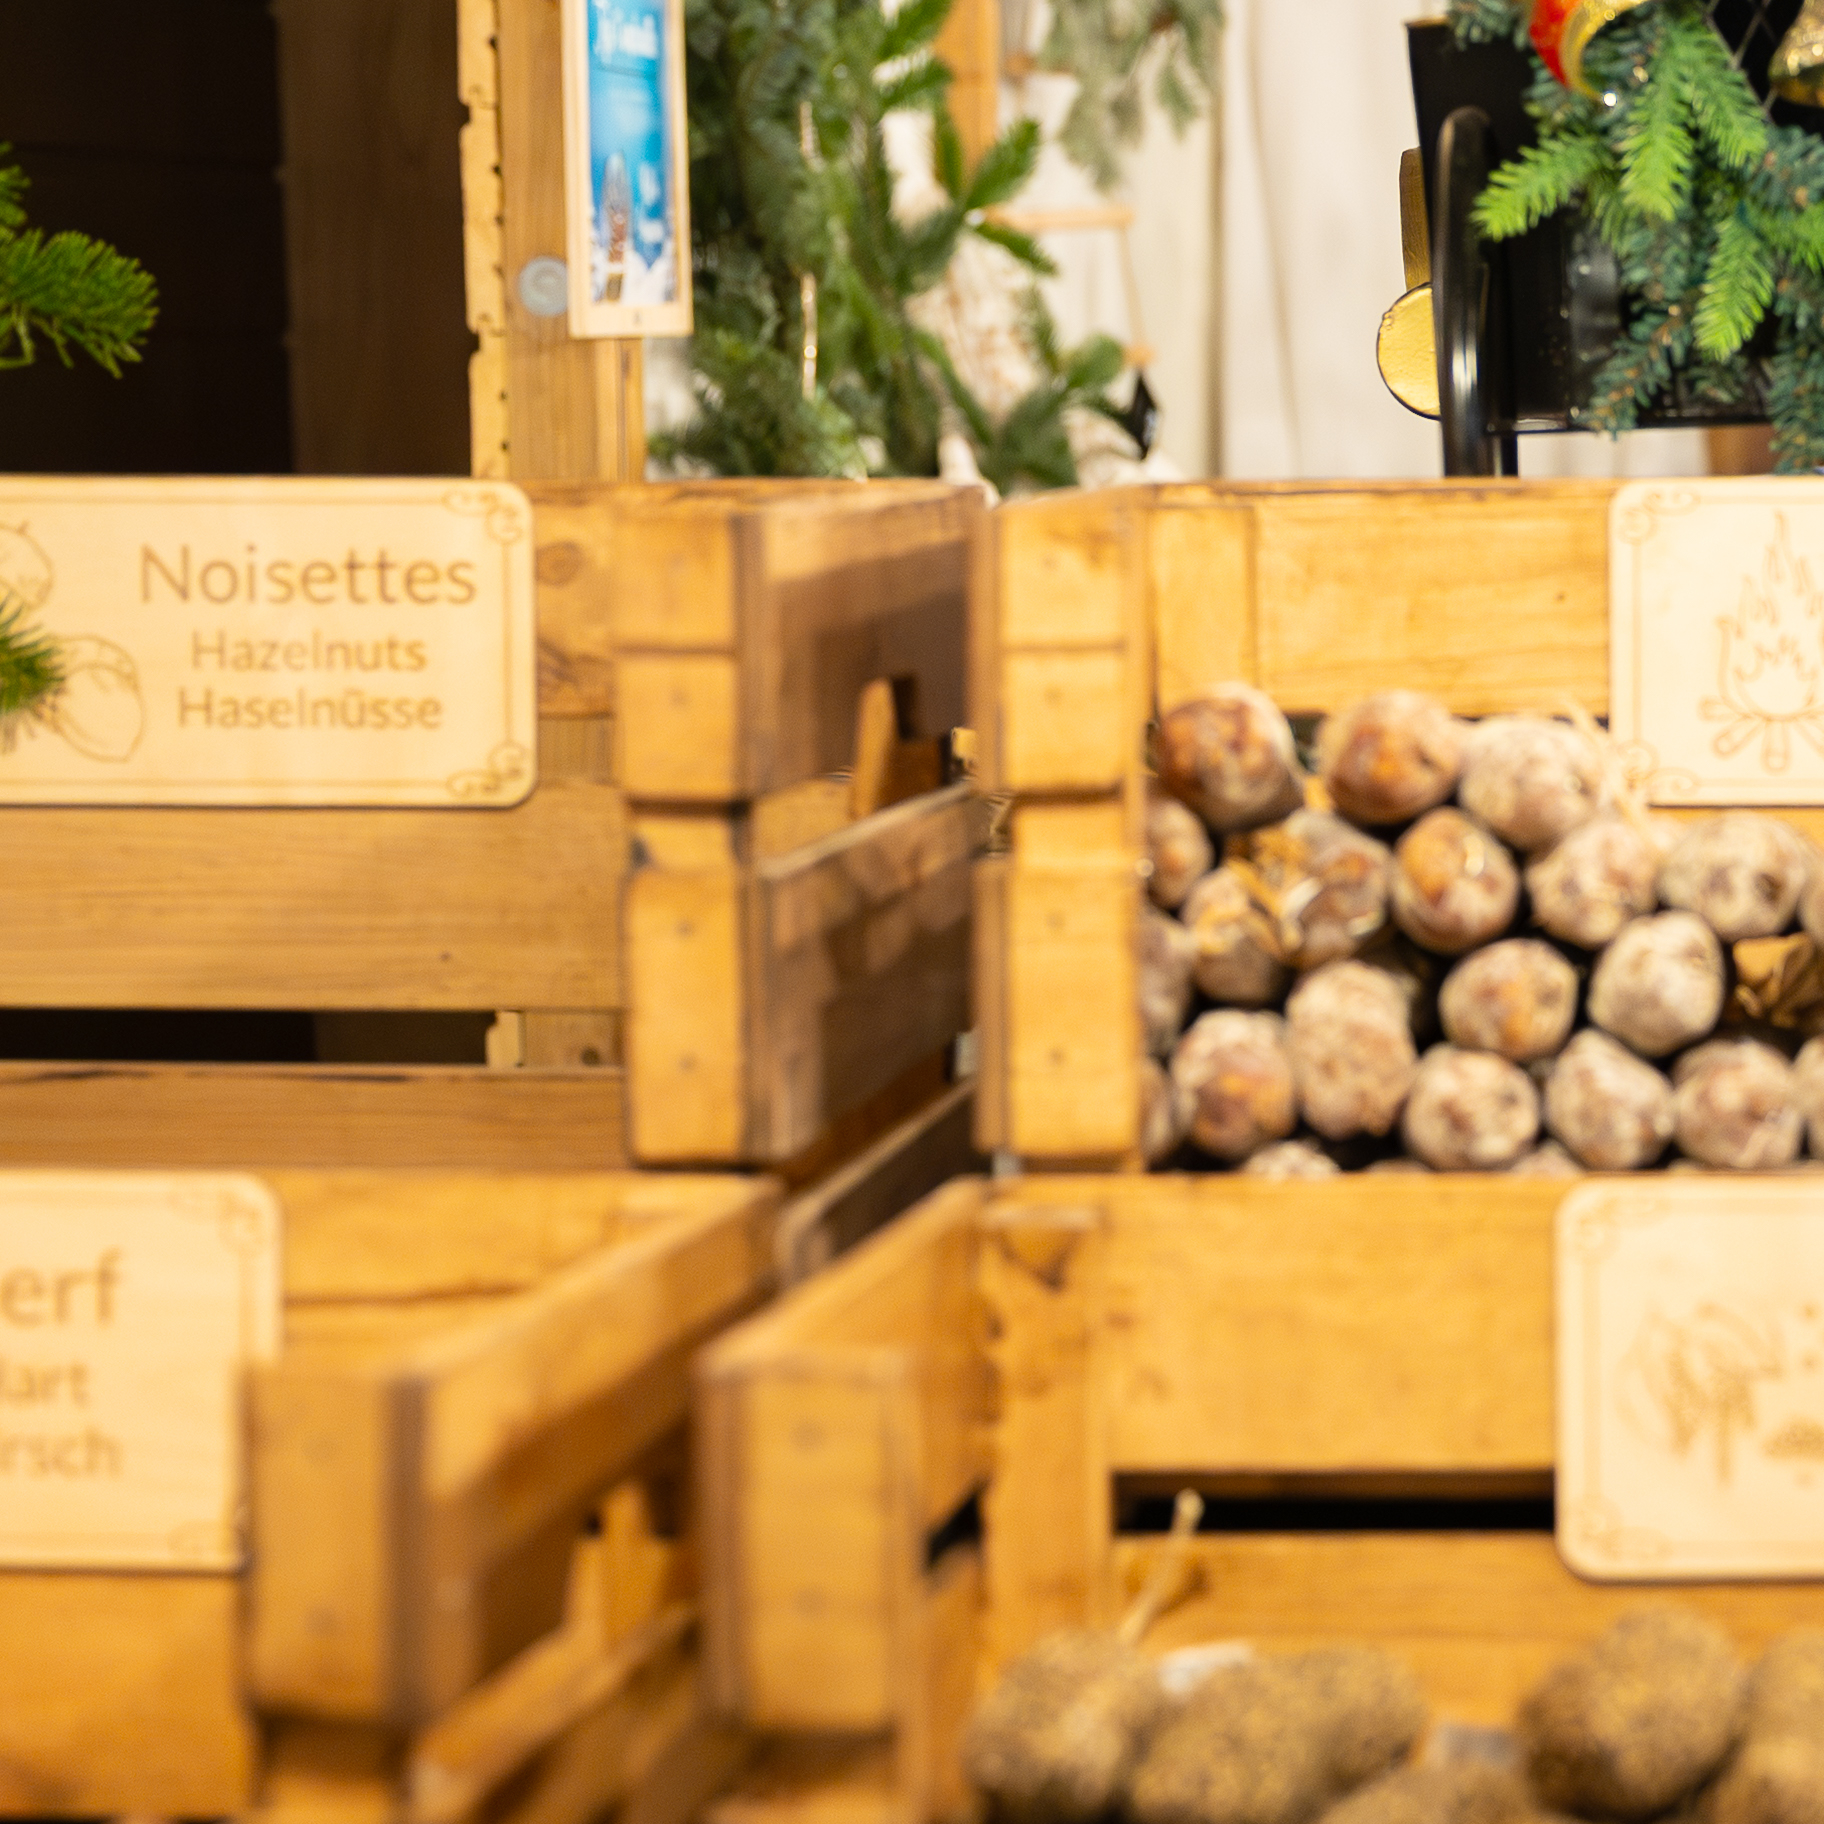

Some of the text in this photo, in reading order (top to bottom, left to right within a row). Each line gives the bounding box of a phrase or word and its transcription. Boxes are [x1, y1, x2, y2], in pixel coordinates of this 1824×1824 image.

[140, 543, 478, 605] Noisettes
[190, 628, 428, 673] Hazelnuts
[177, 685, 444, 730] Haselnüsse
[0, 1356, 91, 1408] art
